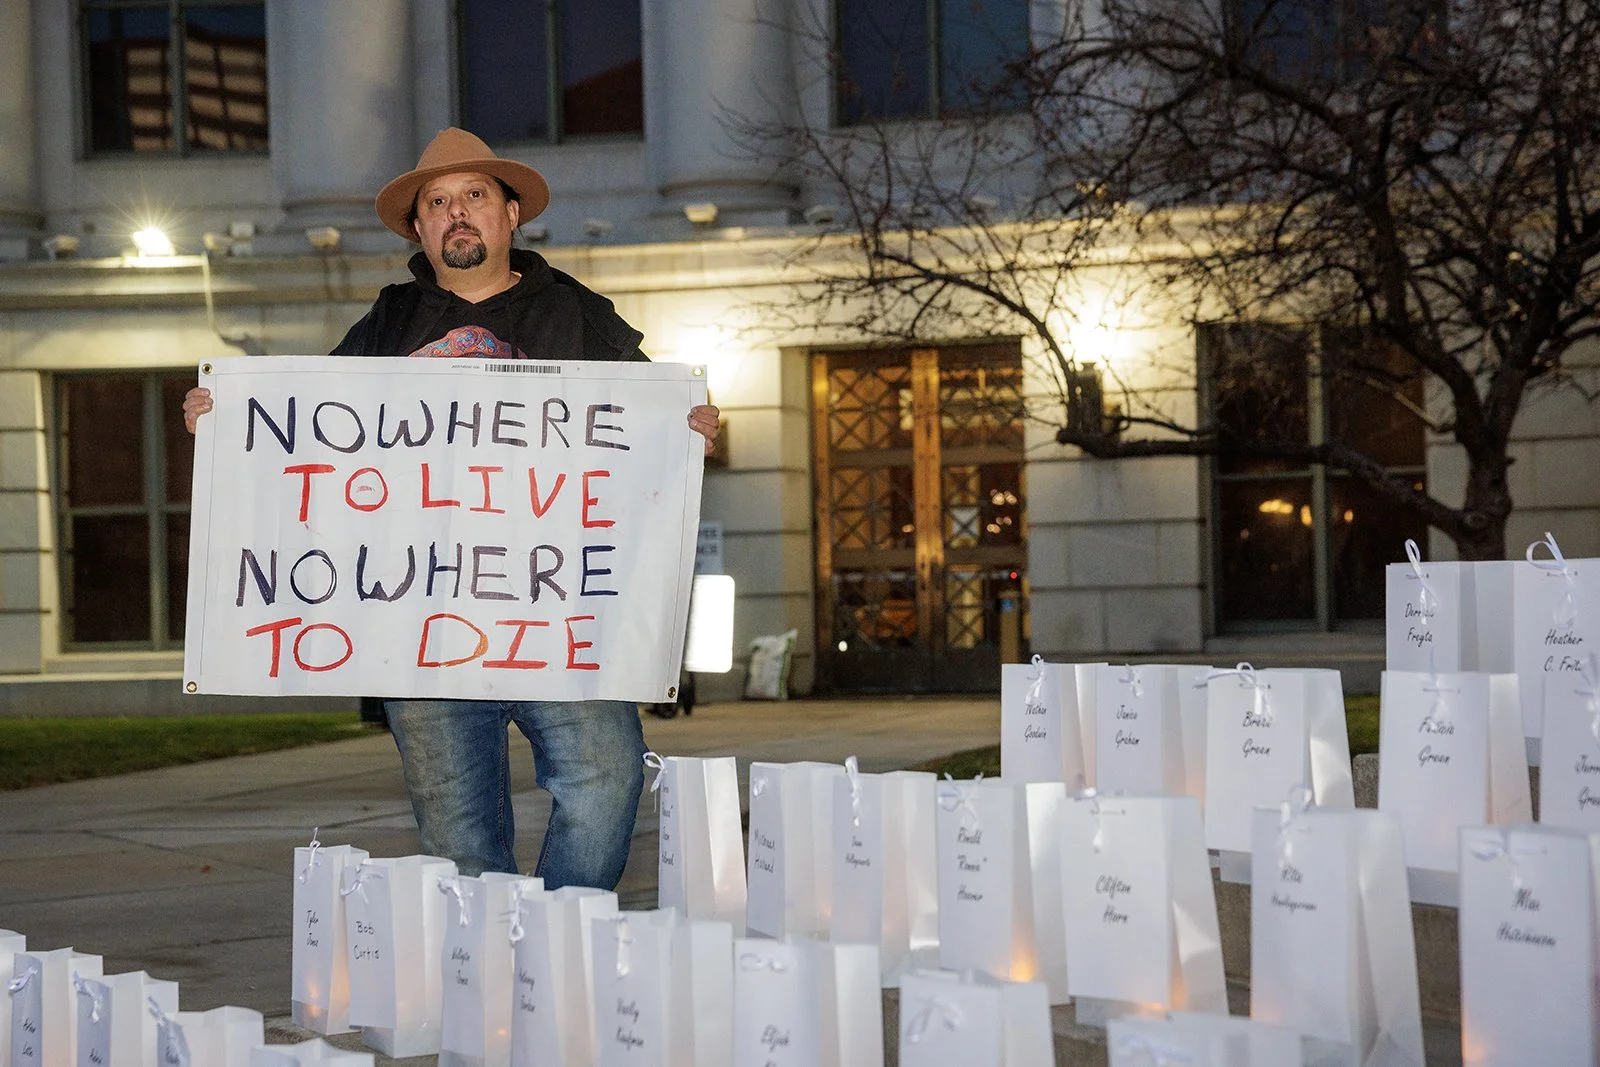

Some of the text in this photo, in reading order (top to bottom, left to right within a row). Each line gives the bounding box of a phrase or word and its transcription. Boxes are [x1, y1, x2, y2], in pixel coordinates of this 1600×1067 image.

[245, 395, 630, 454] NOWHERE
[283, 462, 616, 529] TO LIVE
[235, 541, 618, 608] NOWHERE
[245, 612, 600, 678] TO DIE
[353, 944, 380, 961] Curtis
[355, 920, 375, 935] Bob
